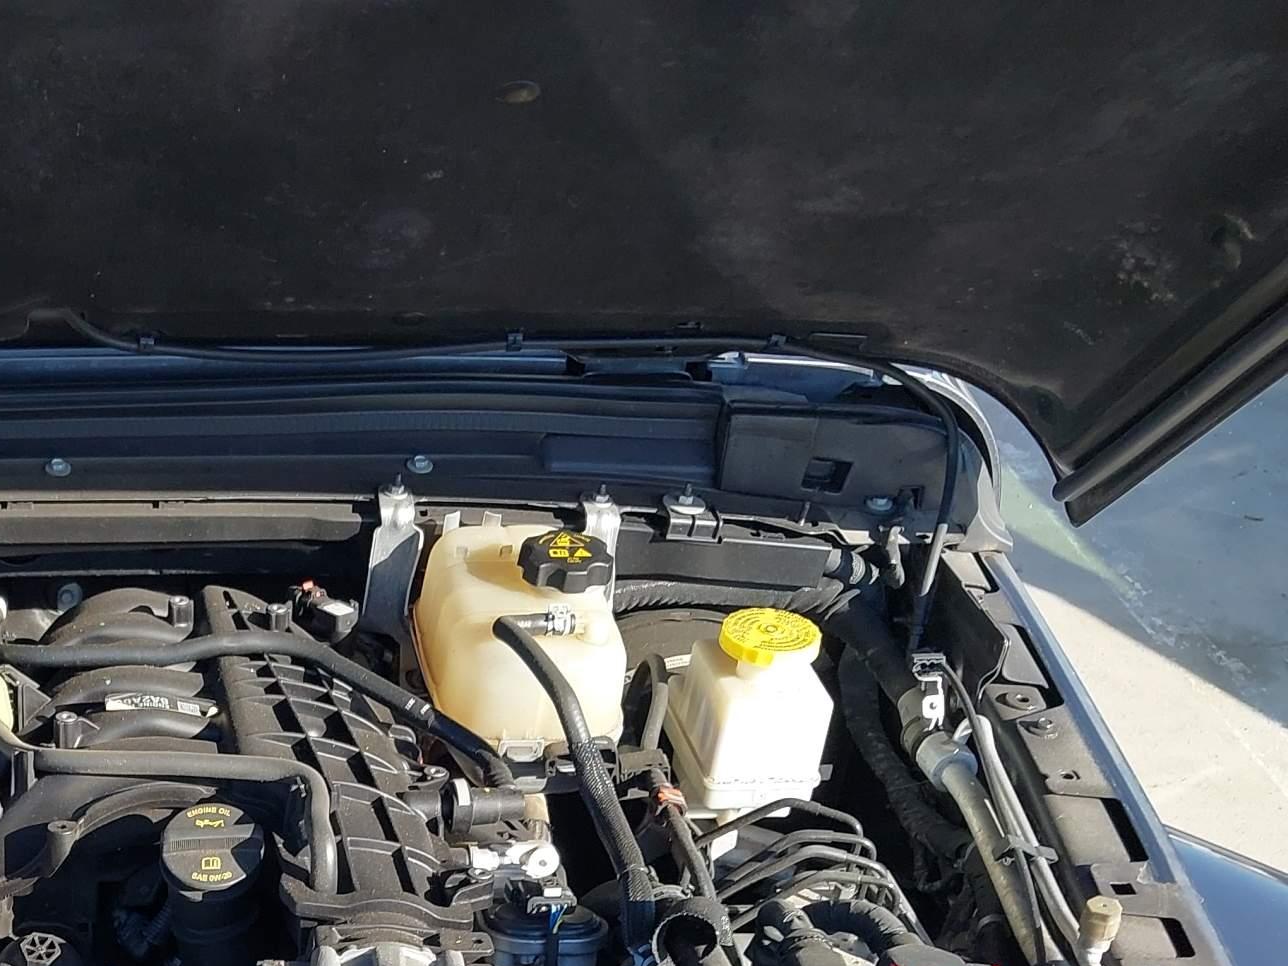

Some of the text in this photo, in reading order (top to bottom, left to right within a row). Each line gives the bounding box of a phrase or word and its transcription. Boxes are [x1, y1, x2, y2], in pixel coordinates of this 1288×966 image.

[186, 806, 231, 818] ENGINE OIL
[191, 872, 208, 882] SAE
